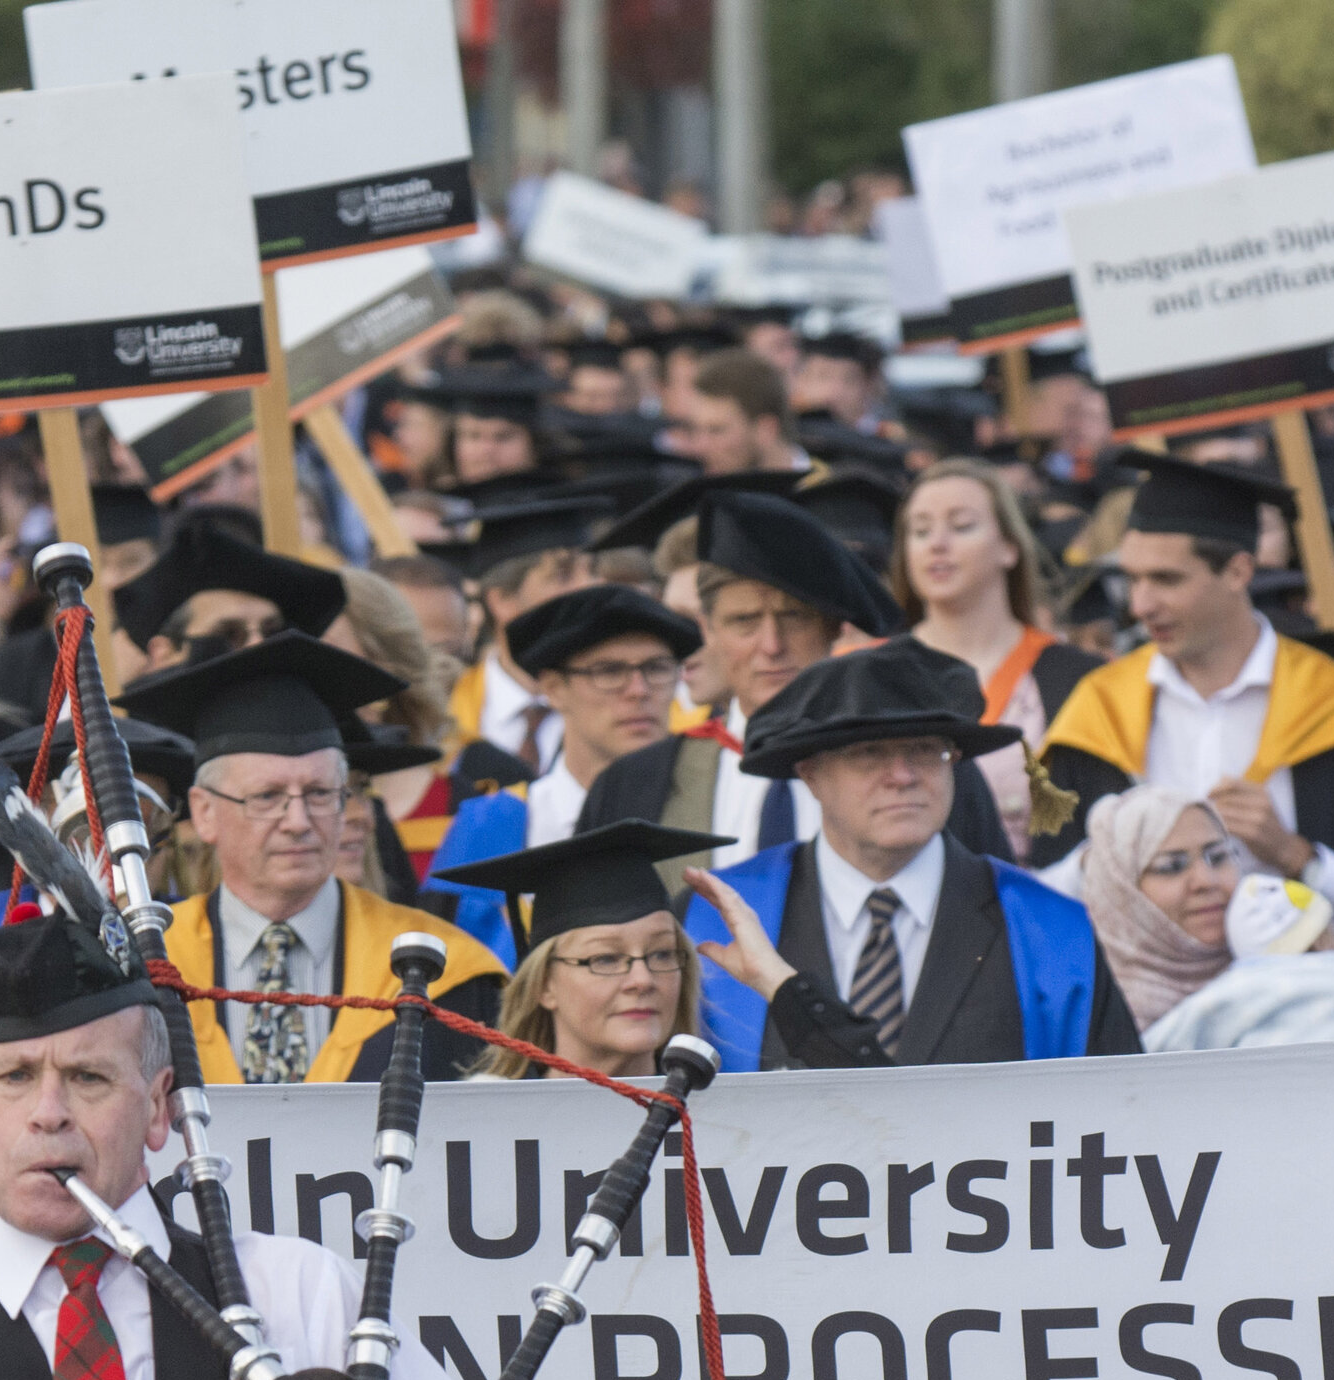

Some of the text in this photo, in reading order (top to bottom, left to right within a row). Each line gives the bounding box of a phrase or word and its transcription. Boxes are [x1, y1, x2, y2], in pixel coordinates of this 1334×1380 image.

[1093, 236, 1267, 284] Postgraduate
[1153, 285, 1202, 316] and
[145, 320, 219, 344] Lincoln
[147, 336, 243, 361] University
[446, 1121, 1222, 1281] University
